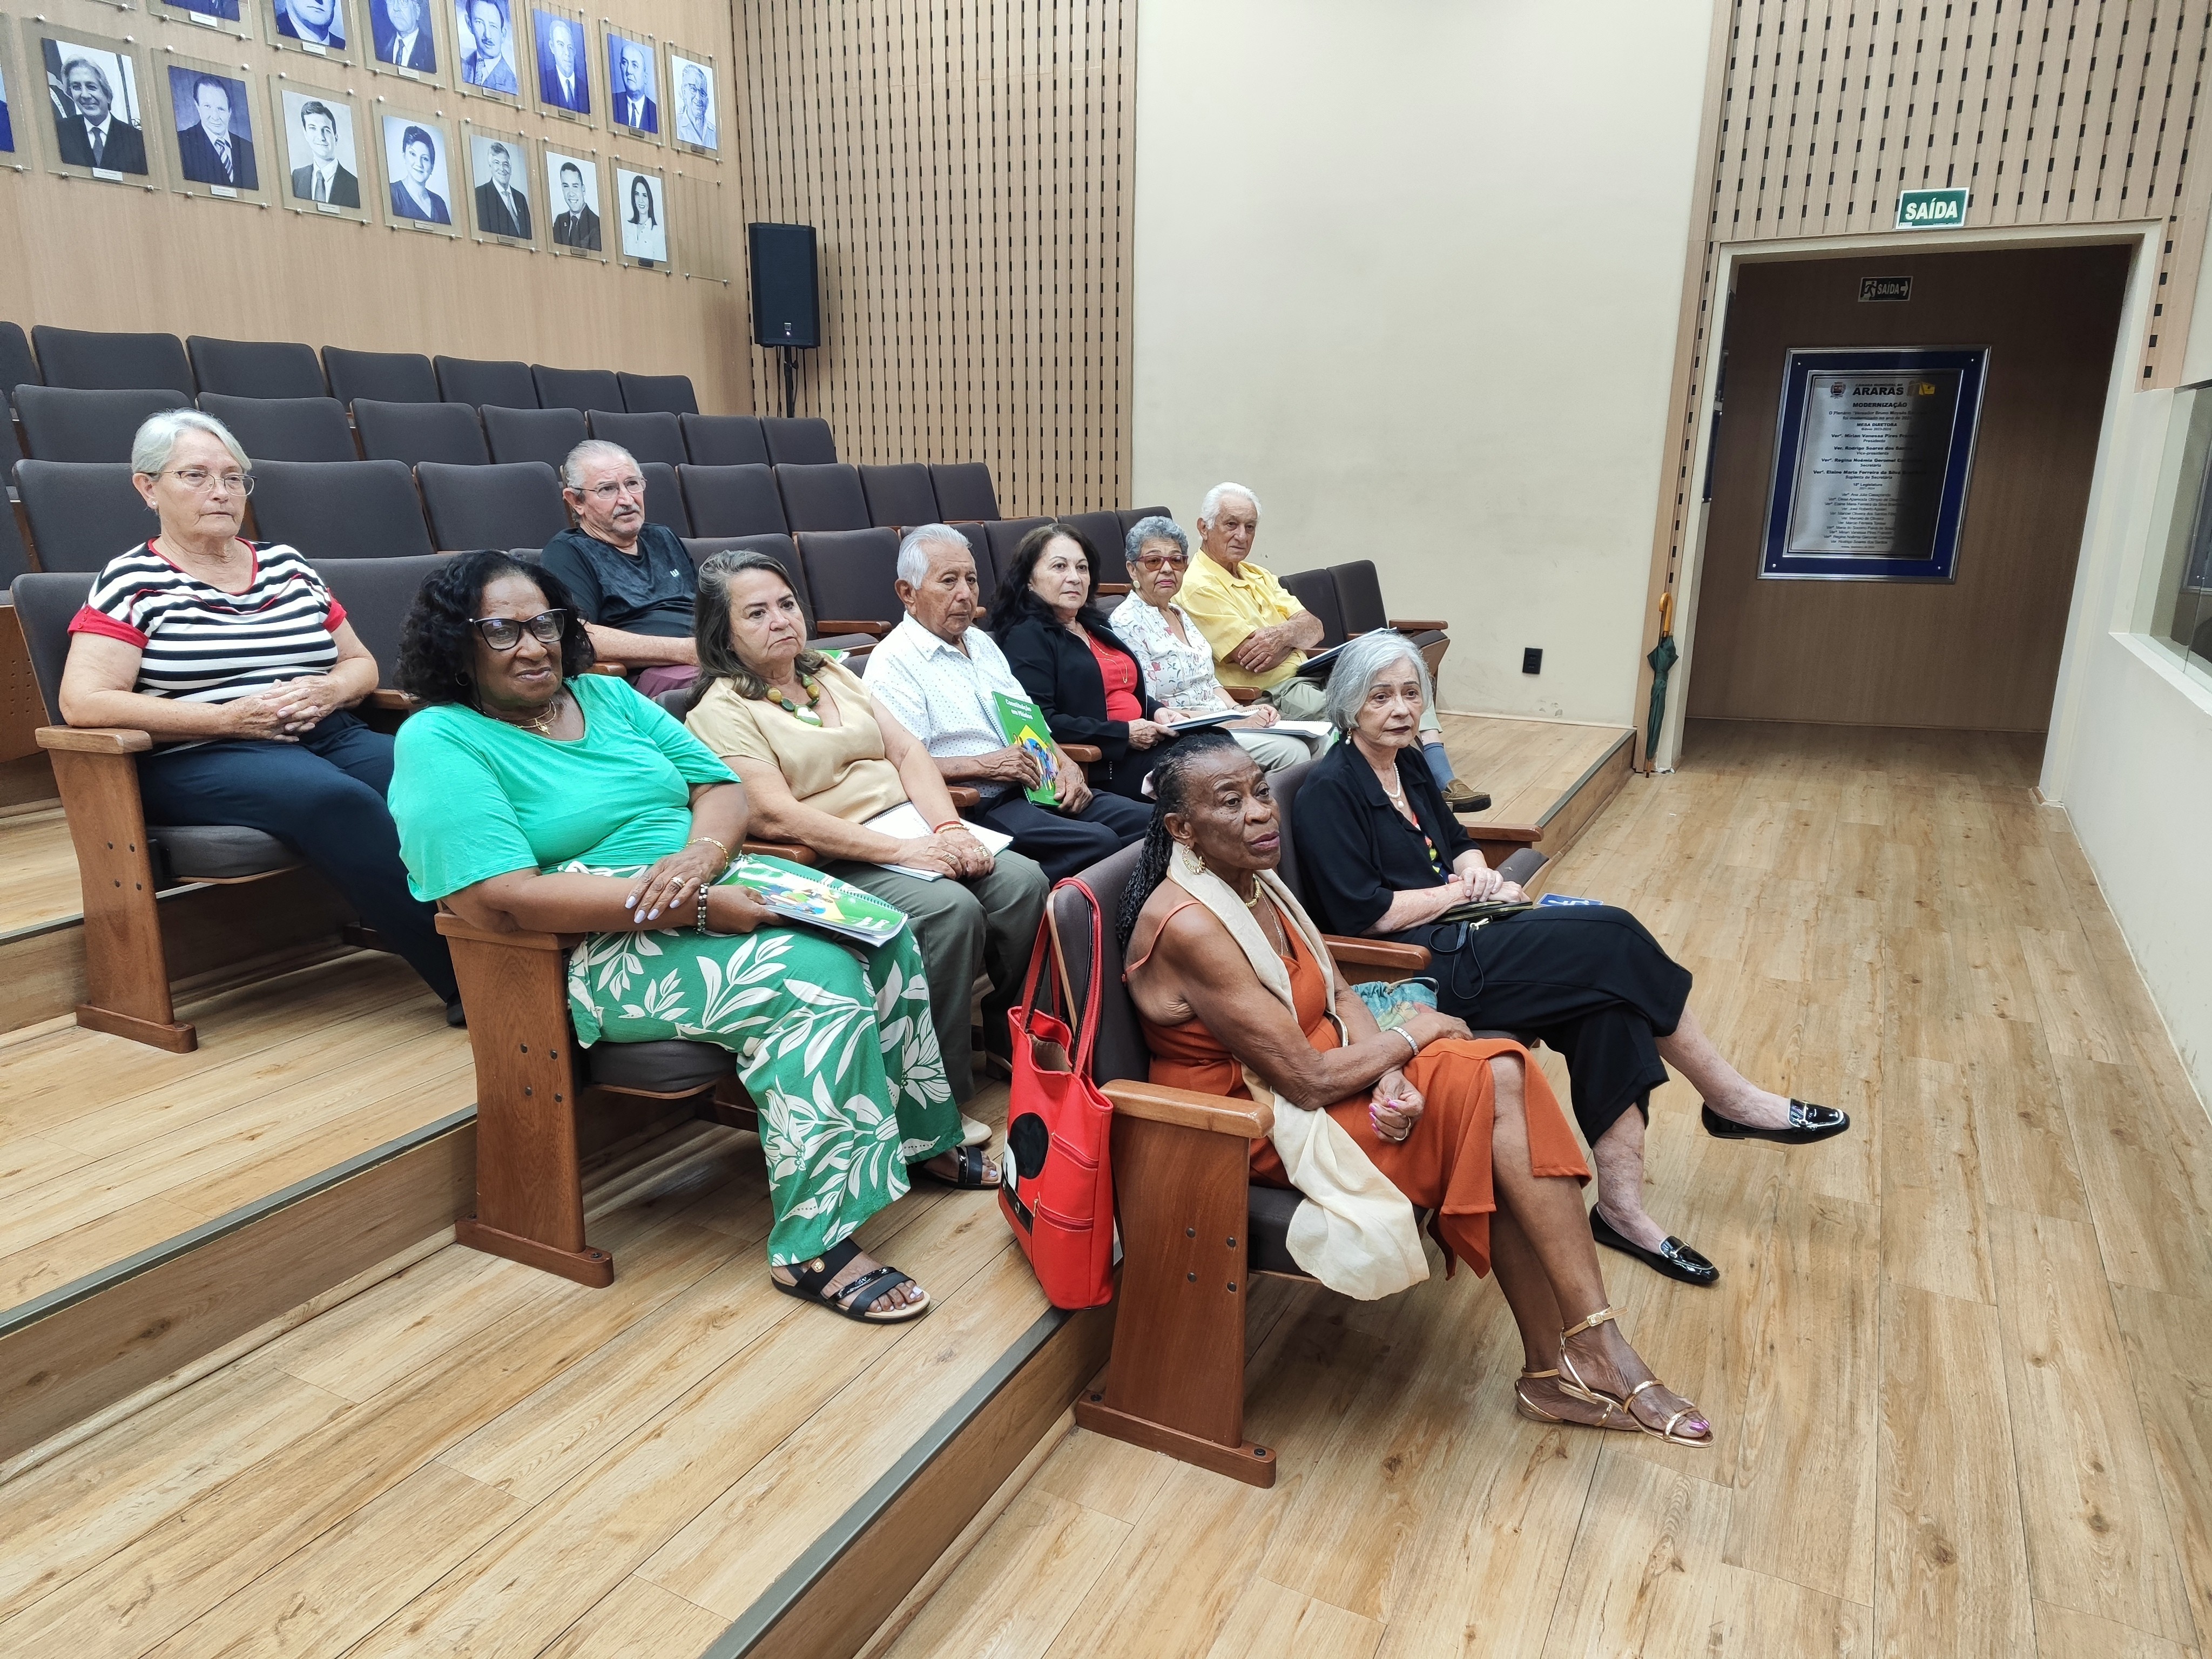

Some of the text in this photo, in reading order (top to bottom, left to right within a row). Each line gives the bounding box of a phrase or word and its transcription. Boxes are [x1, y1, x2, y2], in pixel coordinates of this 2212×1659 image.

[1905, 198, 1958, 220] SAÍDA
[1877, 281, 1899, 294] SAÍDA
[1852, 387, 1904, 395] ARARAS
